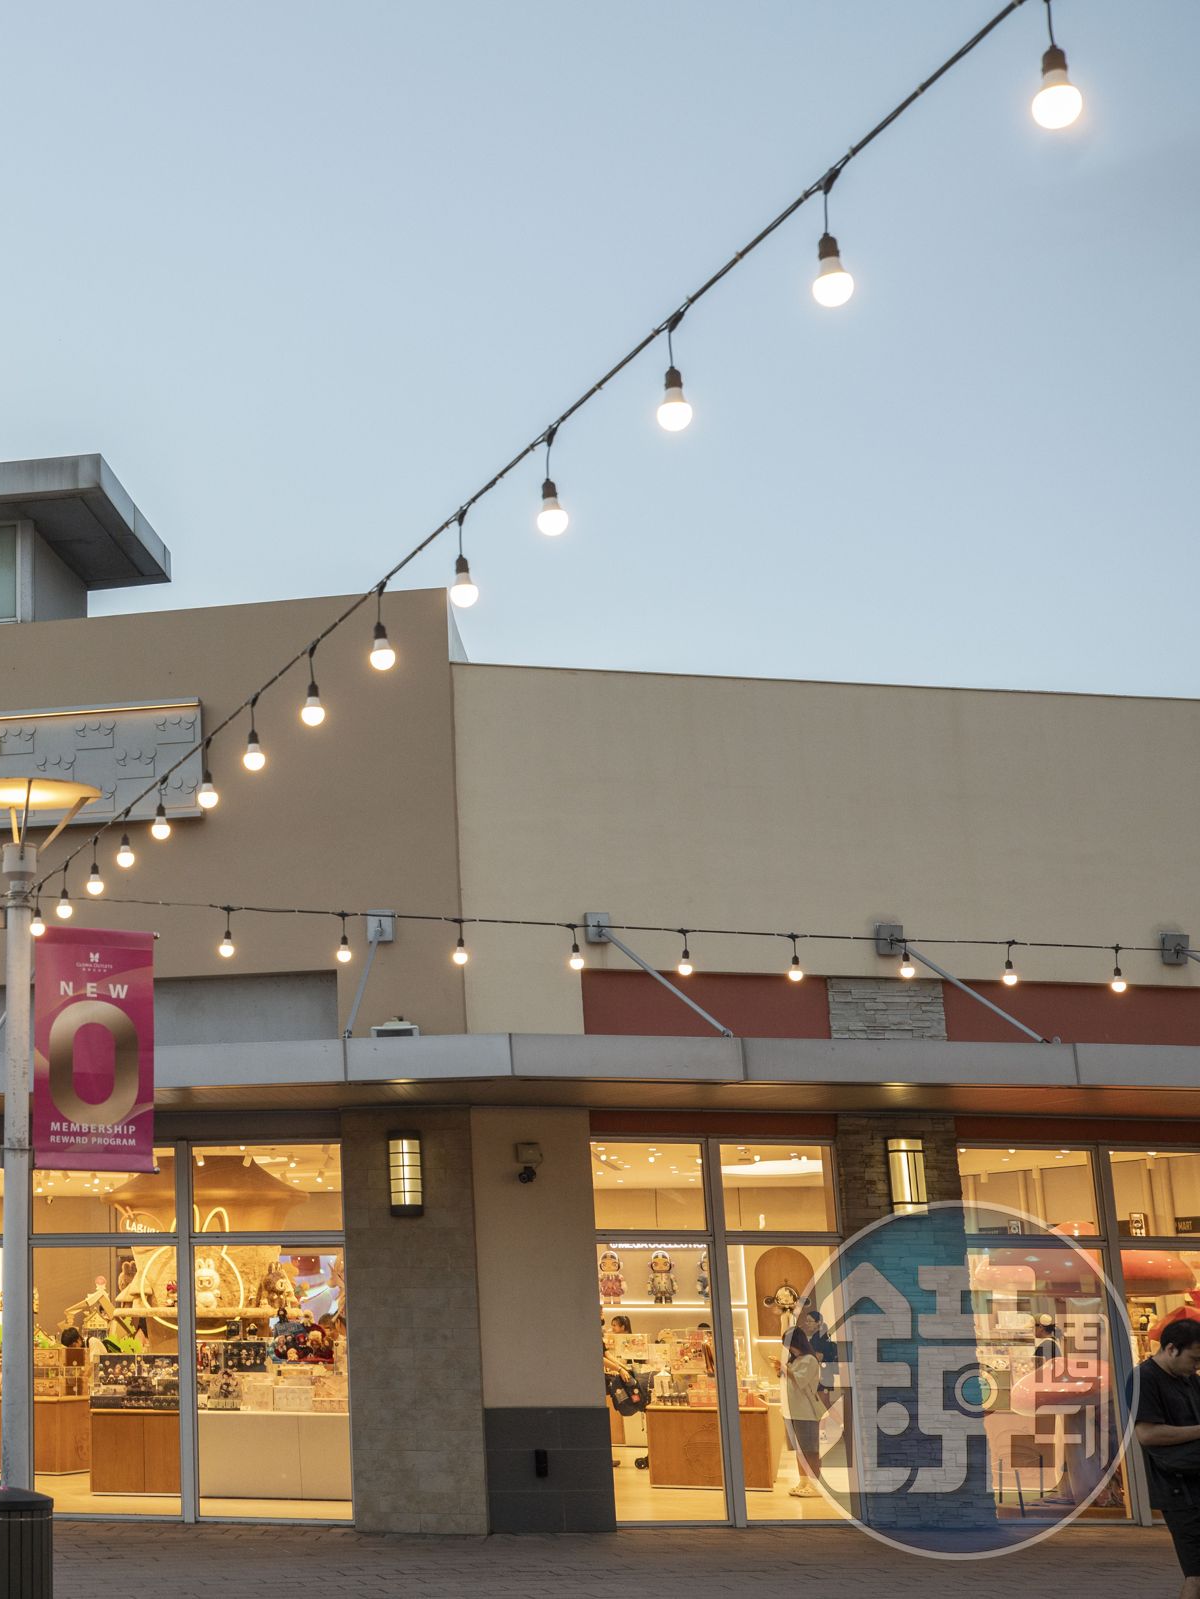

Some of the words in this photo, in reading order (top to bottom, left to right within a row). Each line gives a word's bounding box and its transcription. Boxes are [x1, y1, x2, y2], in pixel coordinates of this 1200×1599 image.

[60, 981, 128, 999] NEW
[49, 1000, 139, 1123] O
[50, 1121, 136, 1135] MEMBERSHIP
[50, 1135, 88, 1145] REWARD
[91, 1136, 136, 1146] PROGRAM
[126, 1219, 160, 1233] LABU
[1178, 1220, 1193, 1231] MART
